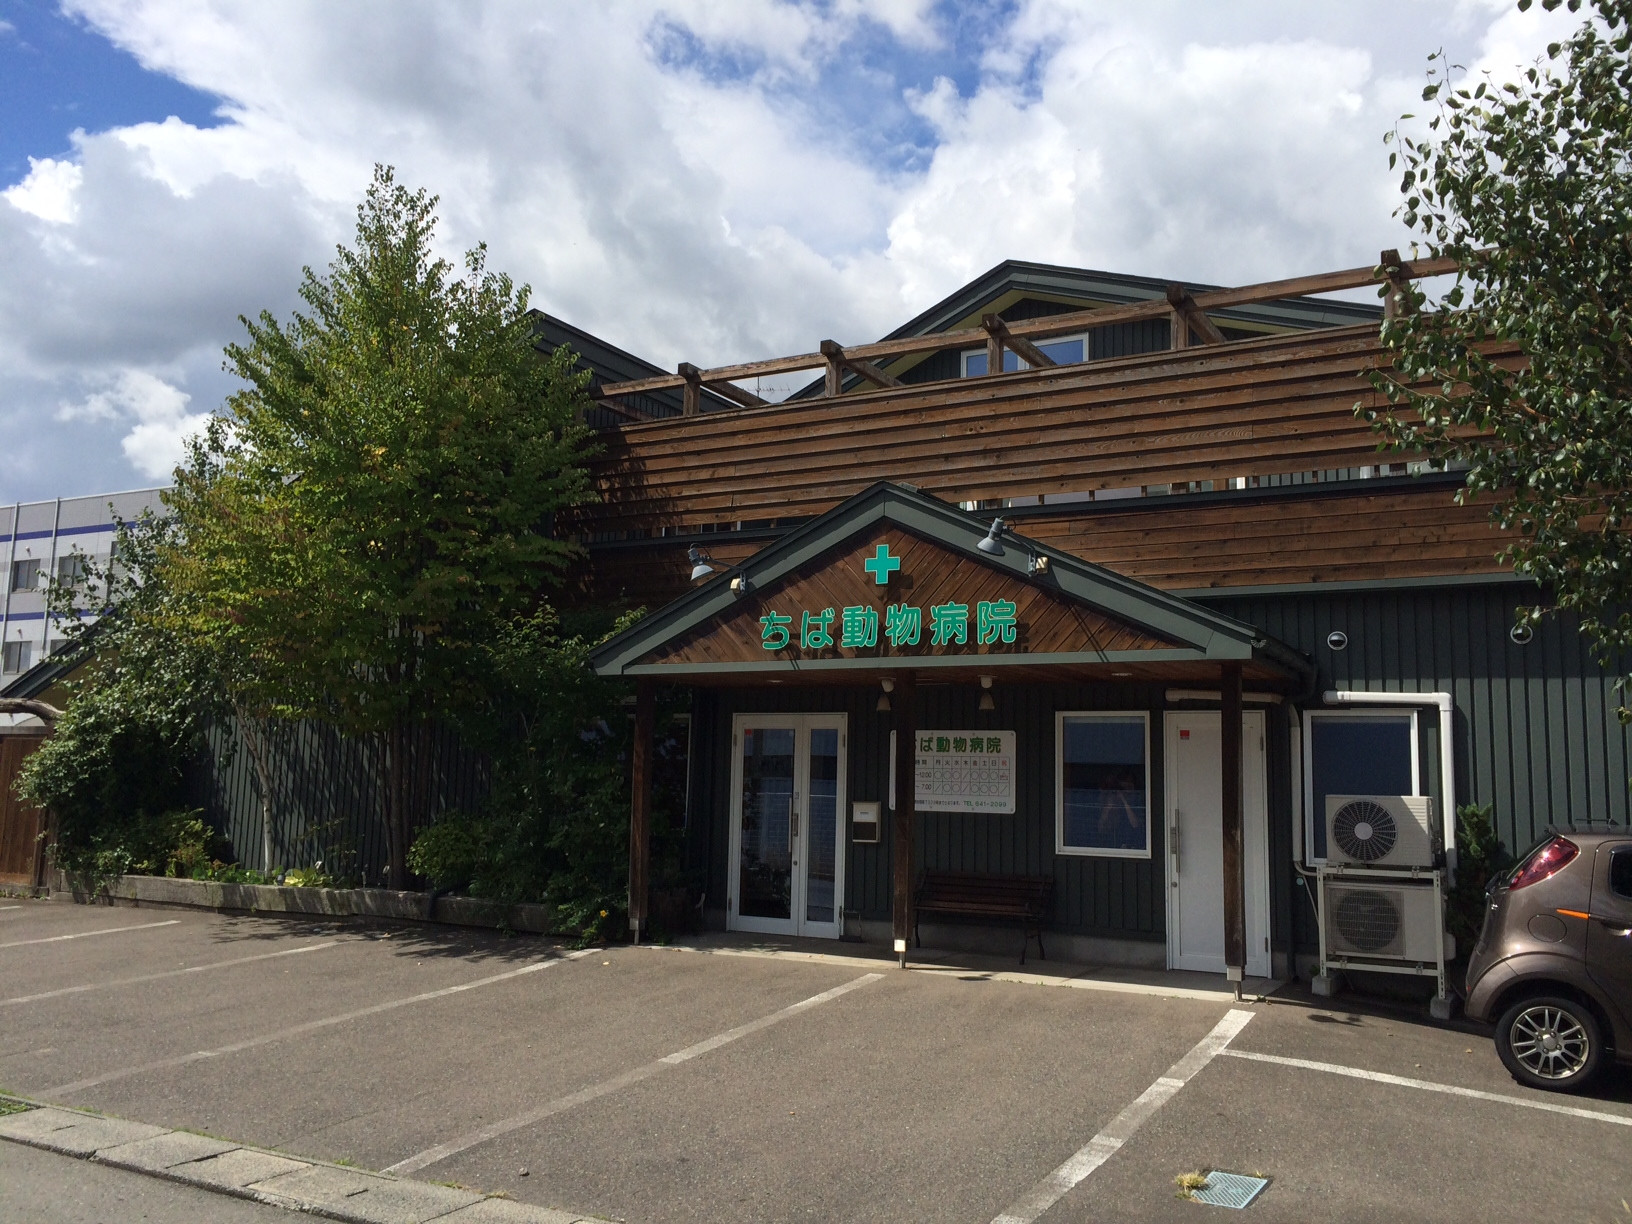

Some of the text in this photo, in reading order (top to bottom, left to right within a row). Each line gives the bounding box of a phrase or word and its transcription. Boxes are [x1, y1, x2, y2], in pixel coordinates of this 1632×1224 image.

[760, 599, 1016, 649] ちば動物病院
[916, 737, 1001, 753] ば動物病院
